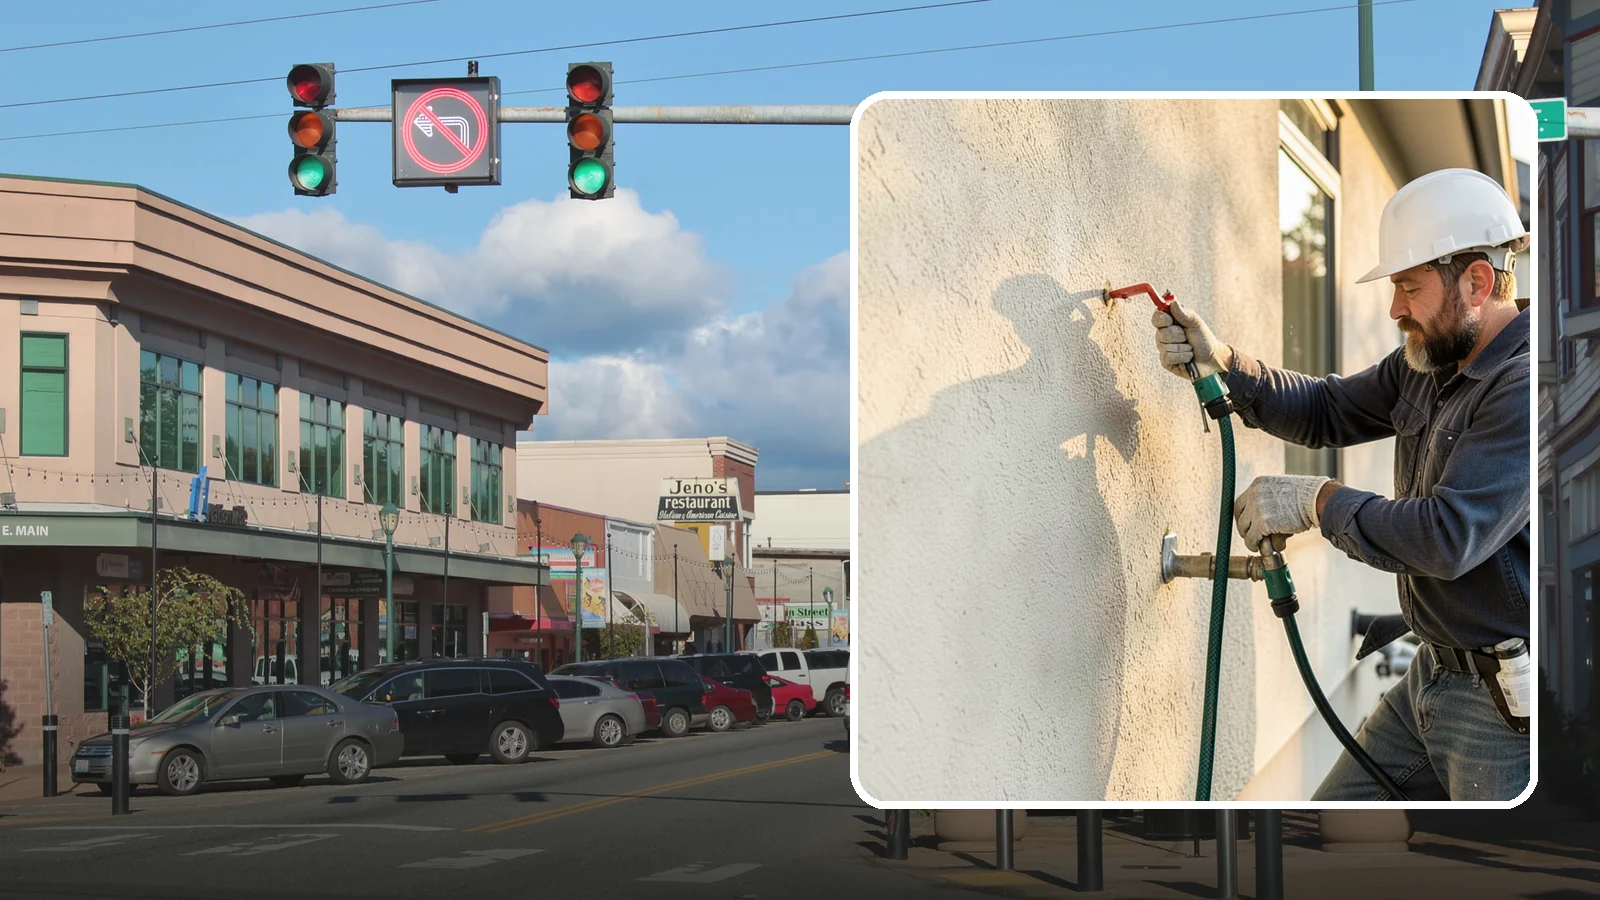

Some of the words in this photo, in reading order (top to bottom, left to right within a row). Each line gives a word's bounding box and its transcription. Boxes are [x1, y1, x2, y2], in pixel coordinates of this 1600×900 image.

[670, 480, 728, 494] Jeno's
[665, 497, 731, 509] restaurant
[658, 510, 681, 519] Italian
[686, 510, 714, 519] American
[715, 509, 737, 519] Cuisine
[2, 525, 13, 536] E.
[15, 525, 49, 536] MAIN
[797, 608, 828, 617] Street
[791, 619, 824, 627] lass
